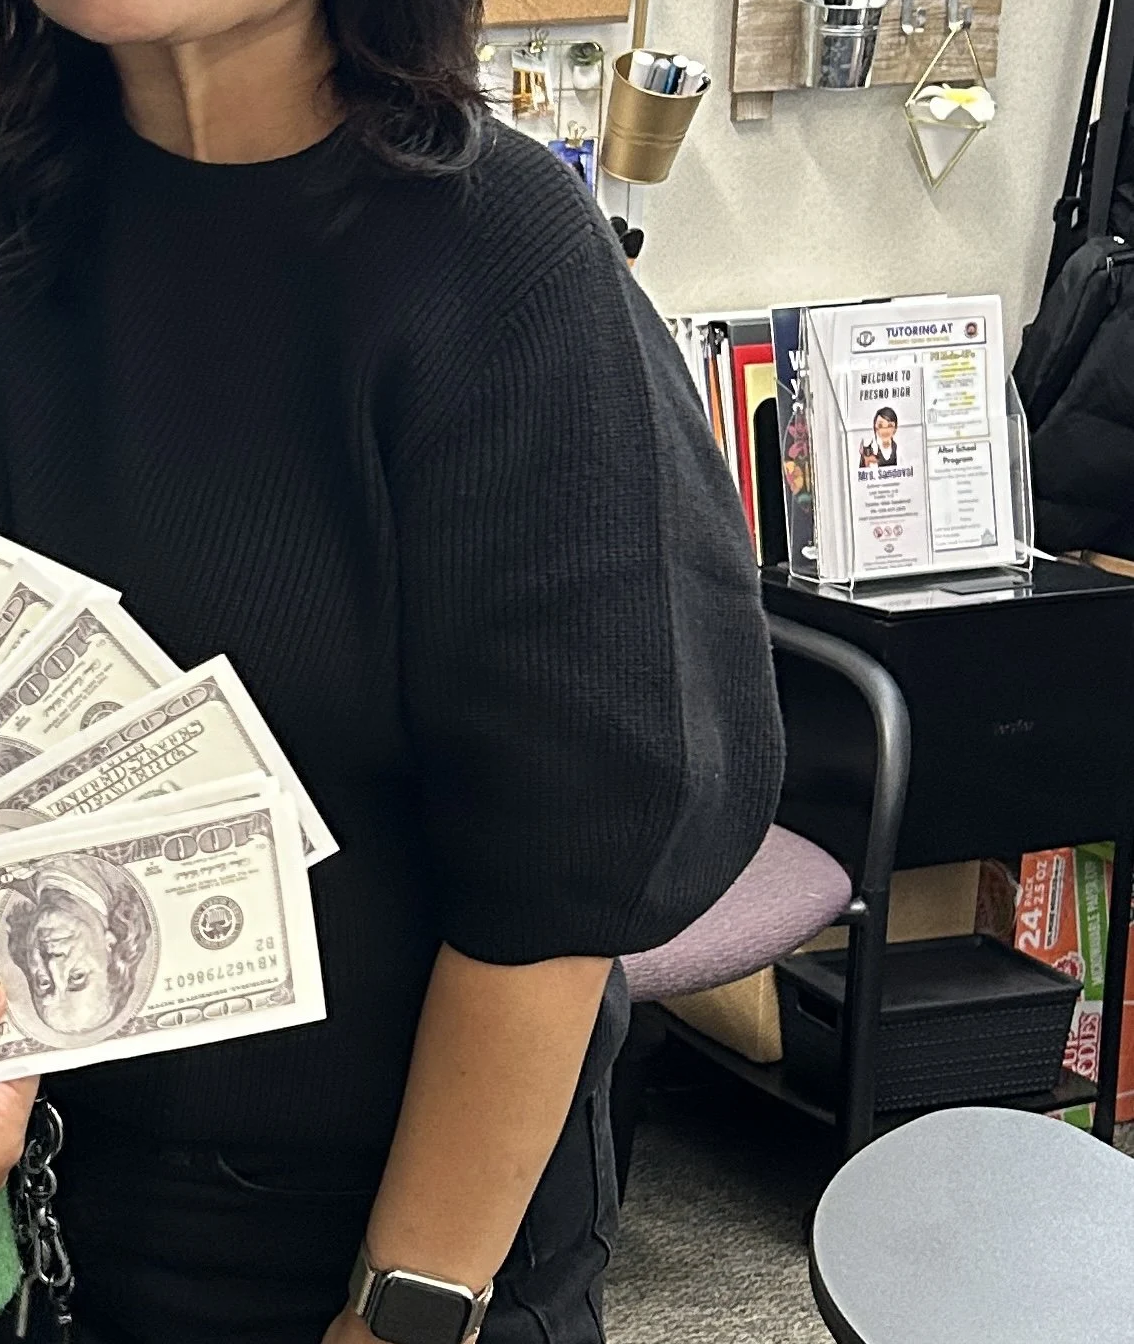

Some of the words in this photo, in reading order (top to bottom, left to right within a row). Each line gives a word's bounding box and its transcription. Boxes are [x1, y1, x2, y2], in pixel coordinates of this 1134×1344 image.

[886, 323, 938, 338] TUTORING
[940, 322, 954, 334] AT
[860, 370, 899, 386] WELCOME
[901, 369, 912, 382] TO
[859, 387, 890, 402] FRESNO
[891, 385, 912, 399] HIGH
[937, 446, 955, 455] After
[955, 444, 978, 454] School
[942, 456, 974, 466] Program
[857, 469, 876, 483] Mrs.
[877, 465, 914, 481] Sandoval
[17, 626, 91, 706] 100
[162, 819, 257, 862] 100
[1035, 859, 1048, 881] OZ
[1024, 877, 1035, 908] PACK
[1033, 883, 1046, 905] 2.5
[1018, 908, 1043, 950] 24
[254, 936, 275, 953] B2
